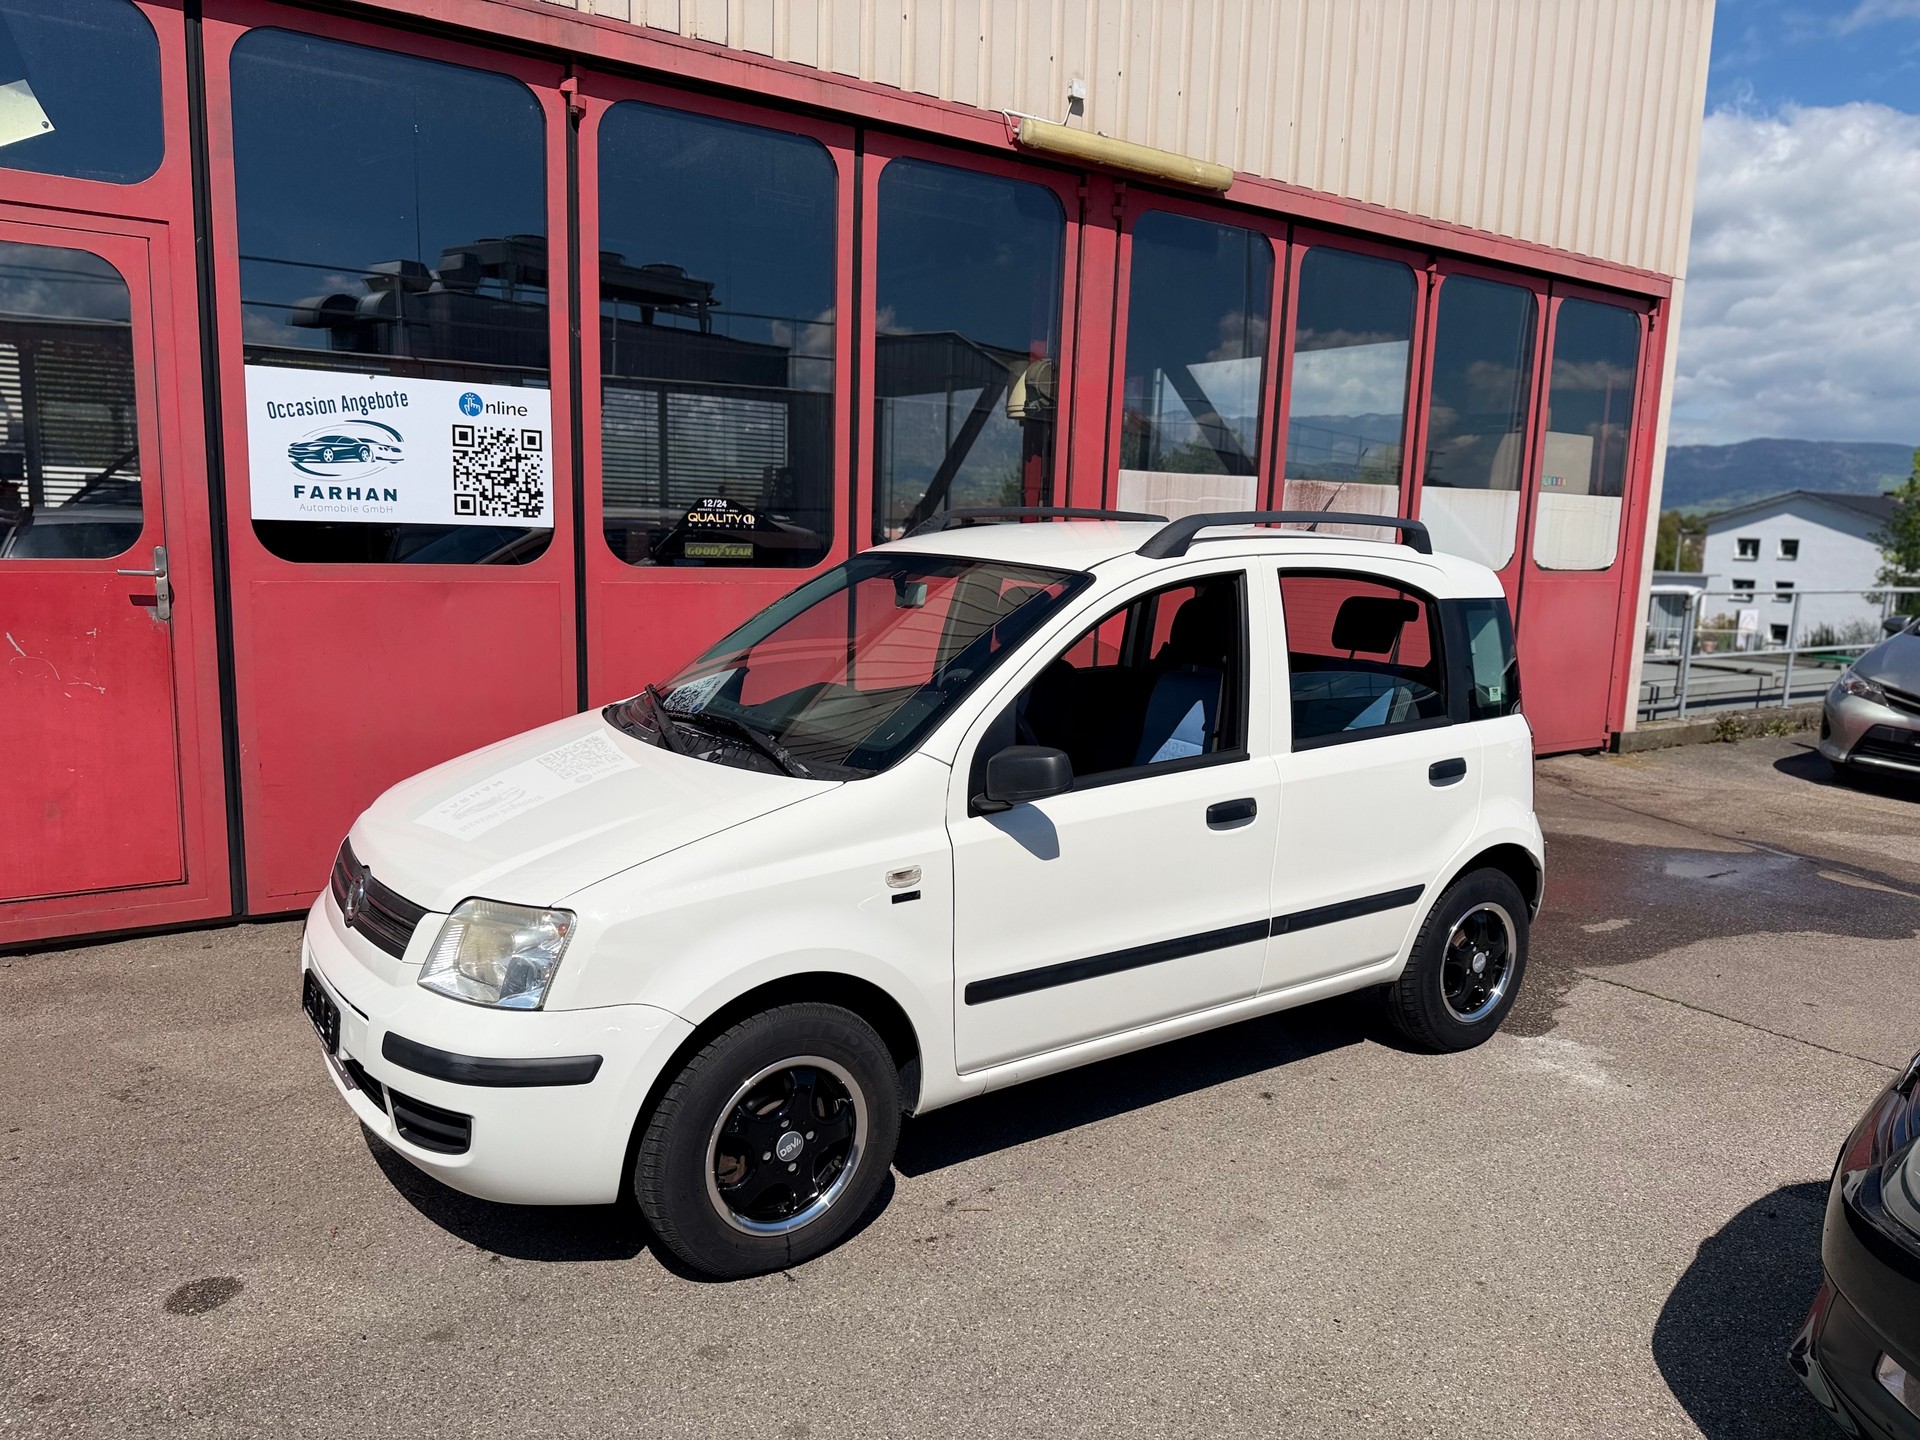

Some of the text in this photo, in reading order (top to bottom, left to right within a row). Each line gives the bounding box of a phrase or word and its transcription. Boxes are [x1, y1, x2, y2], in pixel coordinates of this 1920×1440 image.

[267, 391, 407, 419] Occasion Angebote
[294, 485, 397, 501] FARHAN
[299, 503, 393, 513] Automobile GmbH
[703, 499, 727, 508] 12/24
[688, 512, 742, 523] QUALITY
